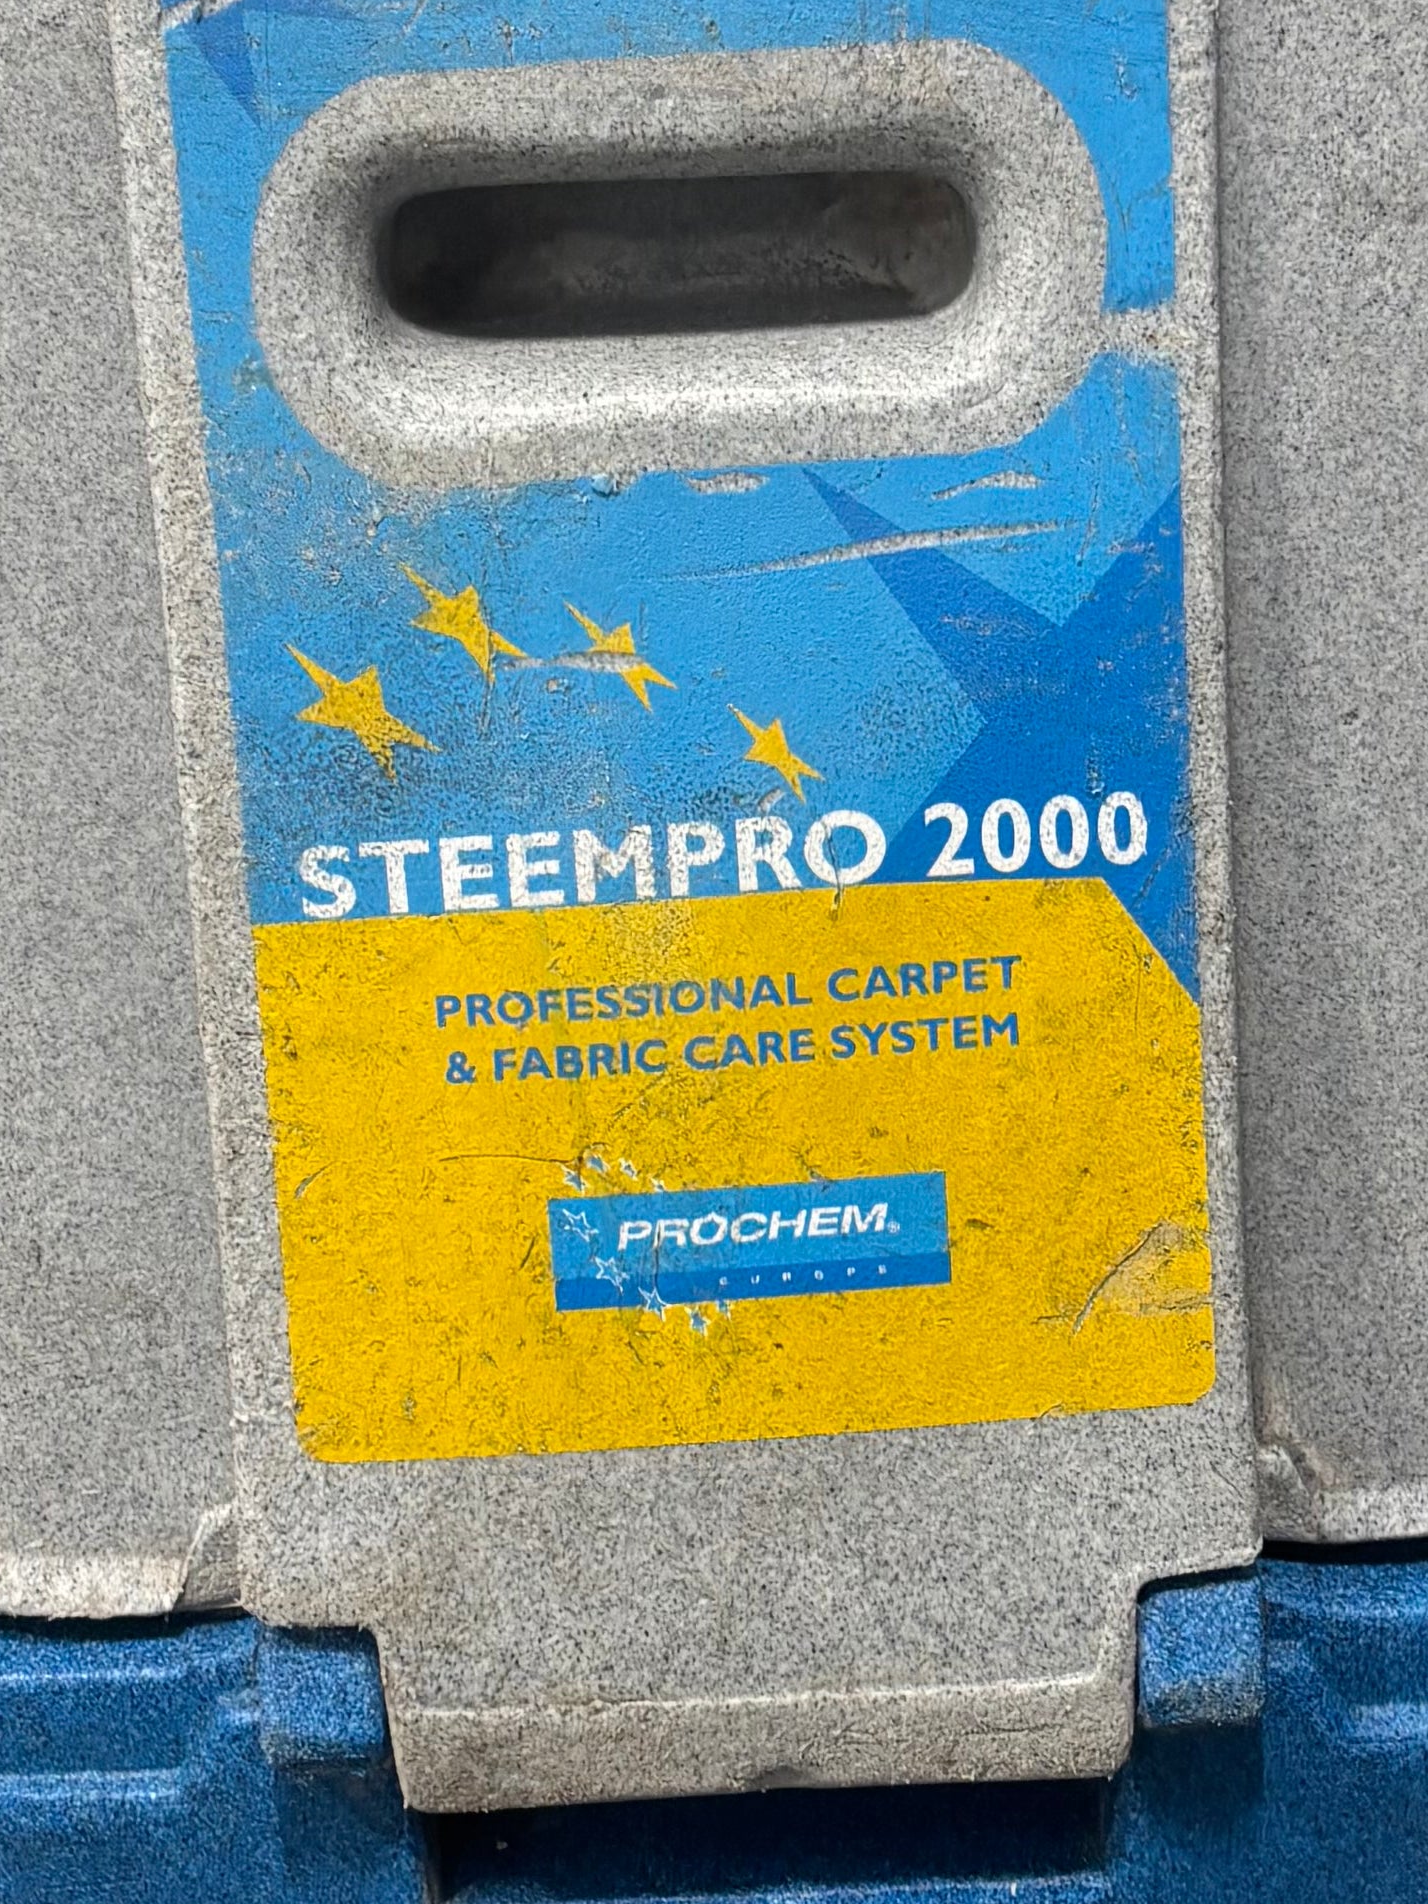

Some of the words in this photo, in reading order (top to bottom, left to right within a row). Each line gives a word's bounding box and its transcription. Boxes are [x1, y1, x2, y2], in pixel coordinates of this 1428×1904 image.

[299, 809, 887, 920] STEEMPRO
[924, 791, 1148, 878] 2000
[435, 973, 813, 1029] PROFESSIONAL
[827, 955, 1022, 1002] CARPET
[445, 1050, 476, 1084] &
[492, 1039, 668, 1082] FABRIC
[683, 1028, 816, 1071] CARE
[829, 1012, 1020, 1059] SYSTEM
